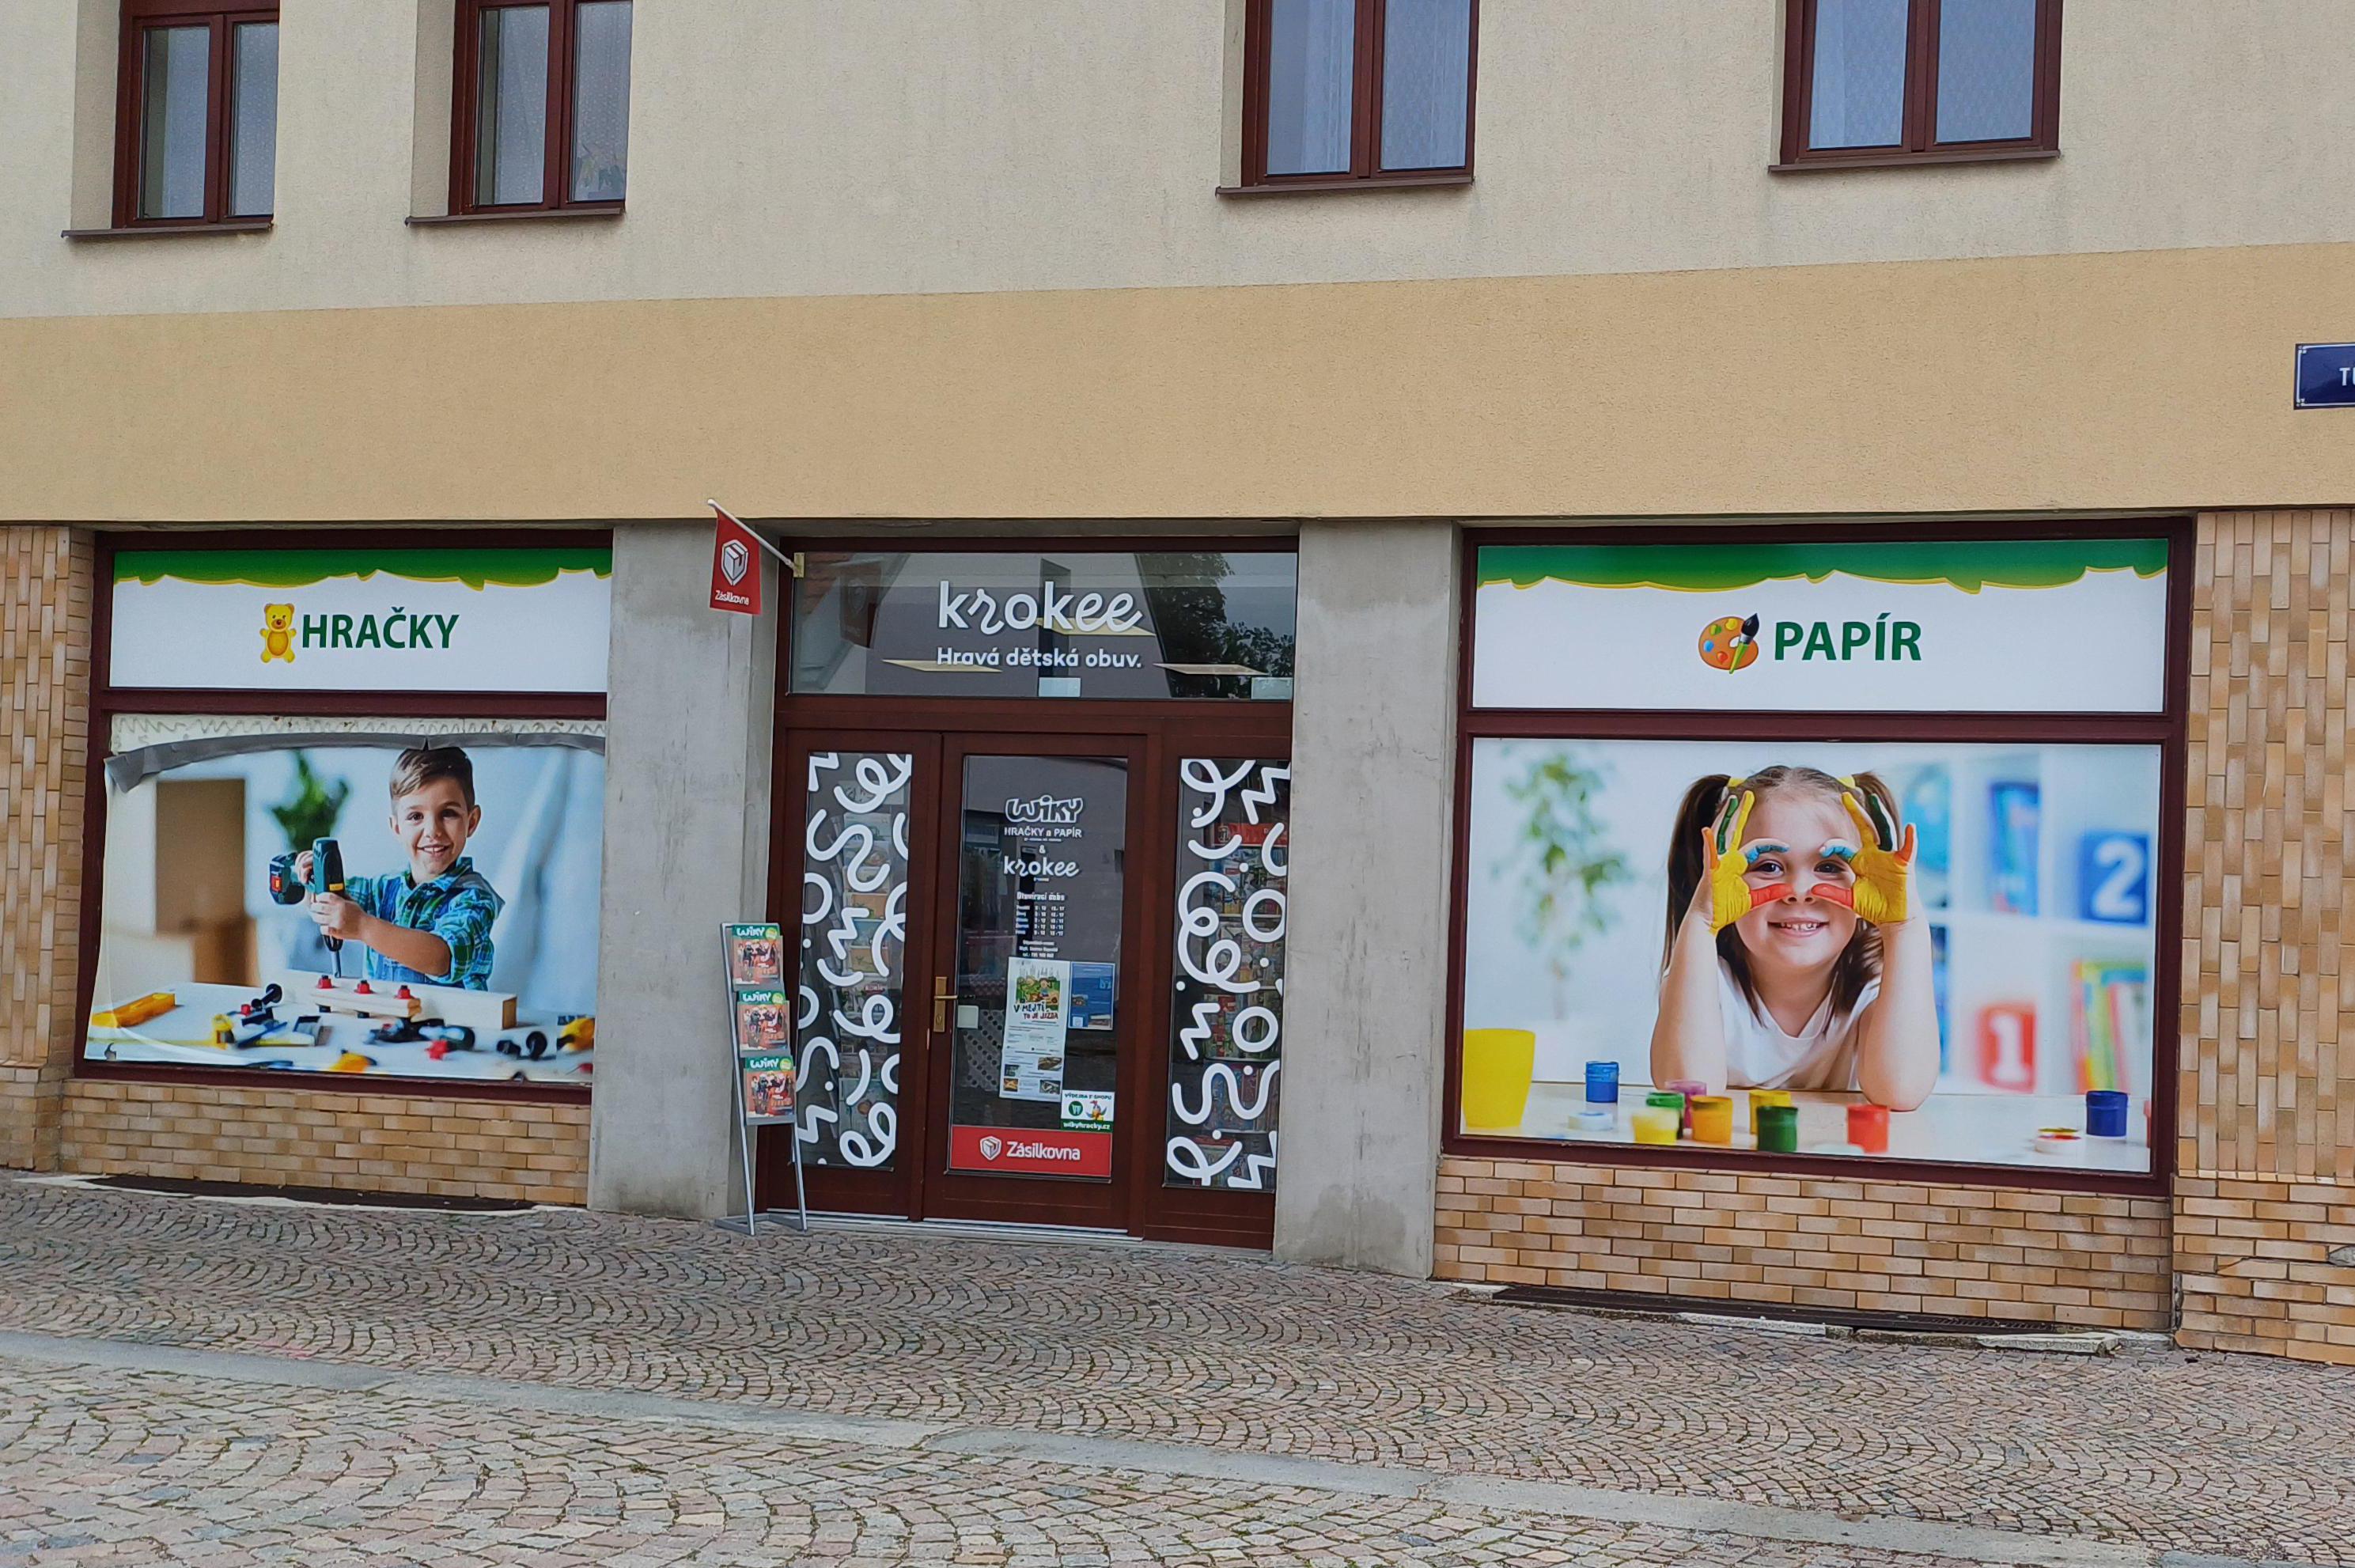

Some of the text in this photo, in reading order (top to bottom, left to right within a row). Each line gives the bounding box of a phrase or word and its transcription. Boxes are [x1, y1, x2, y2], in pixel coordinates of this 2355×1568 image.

[2339, 367, 2355, 386] T
[715, 589, 749, 605] Zásilkovna
[938, 581, 1143, 634] krokee
[302, 606, 460, 649] HRAČKY
[1774, 612, 1921, 661] PAPÍR
[937, 646, 1142, 668] Hravá dětská obuv.
[1004, 825, 1045, 837] HRAČKY
[1054, 827, 1083, 839] PAPÍR
[1003, 855, 1080, 877] krokee
[2092, 838, 2145, 919] 2
[1990, 1014, 2031, 1085] 1
[1005, 1141, 1081, 1161] Zásilkovna
